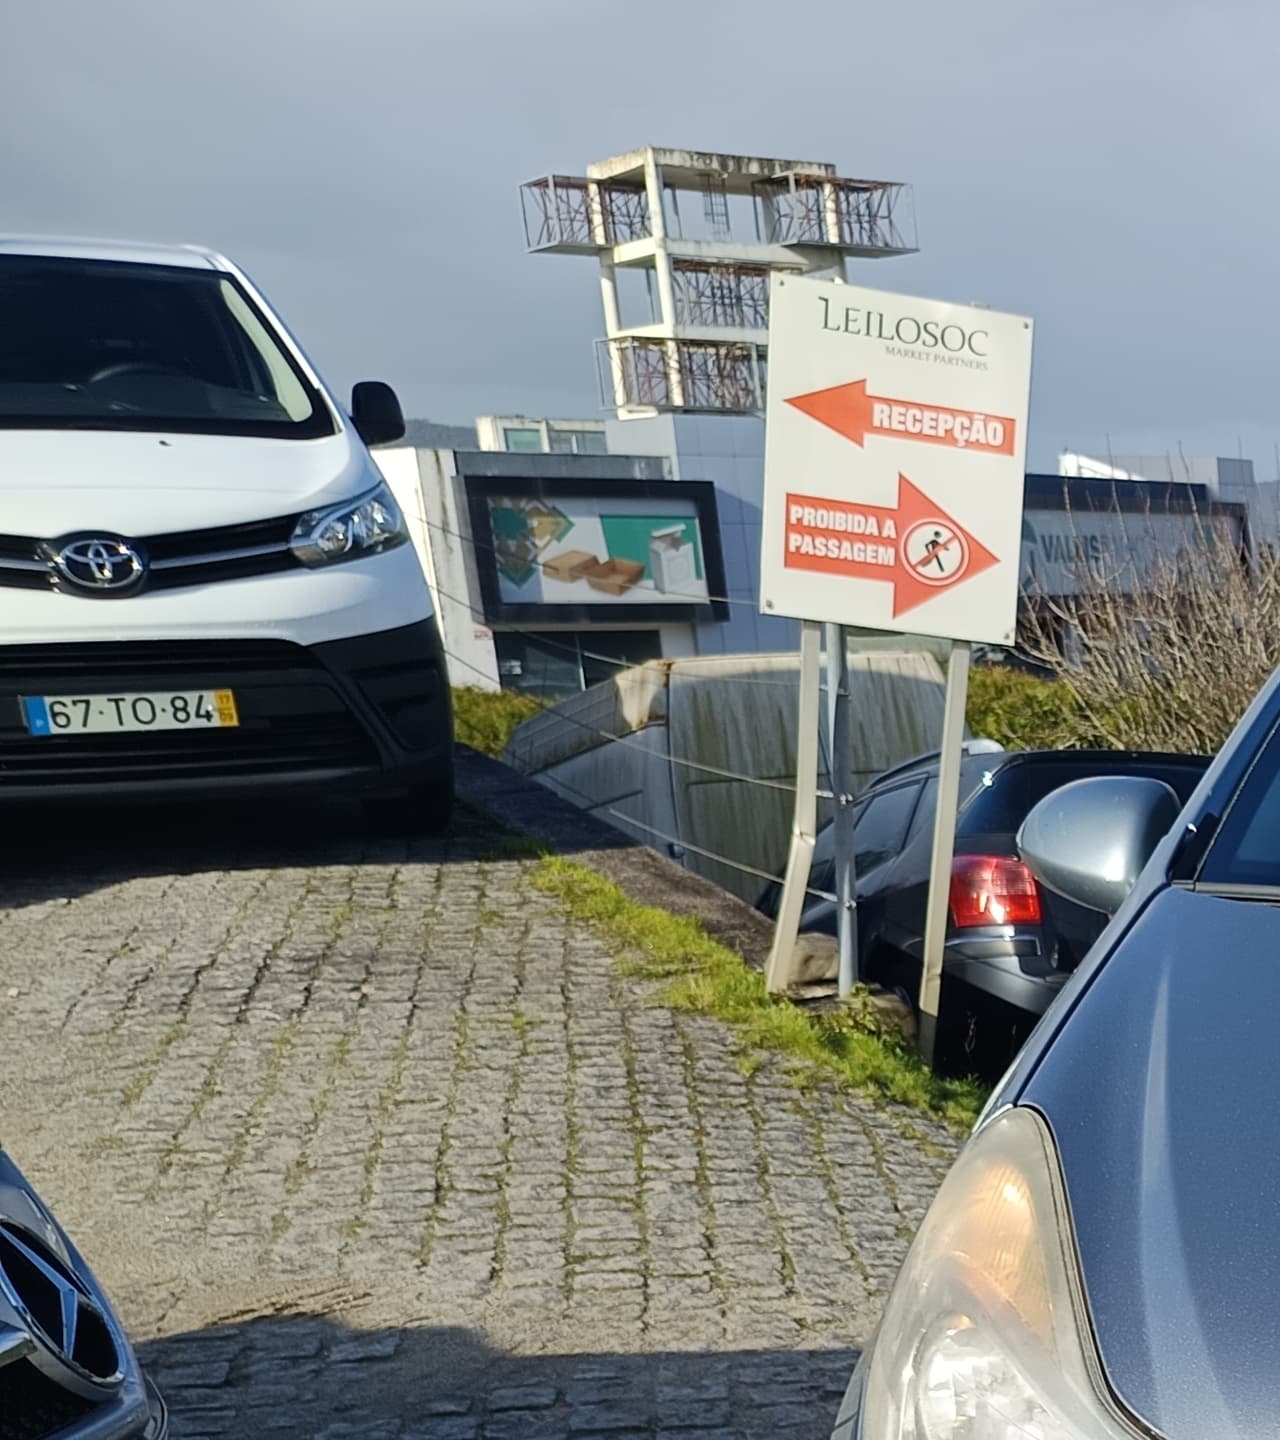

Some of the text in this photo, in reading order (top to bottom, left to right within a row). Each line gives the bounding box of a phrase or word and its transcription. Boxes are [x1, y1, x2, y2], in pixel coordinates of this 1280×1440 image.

[818, 296, 989, 356] LEILOSOC
[885, 346, 989, 371] MARKET PARTNERS
[872, 403, 1005, 447] RECEPÇÃO
[789, 504, 880, 537] PROIBIDA
[788, 532, 896, 567] PASSAGEM
